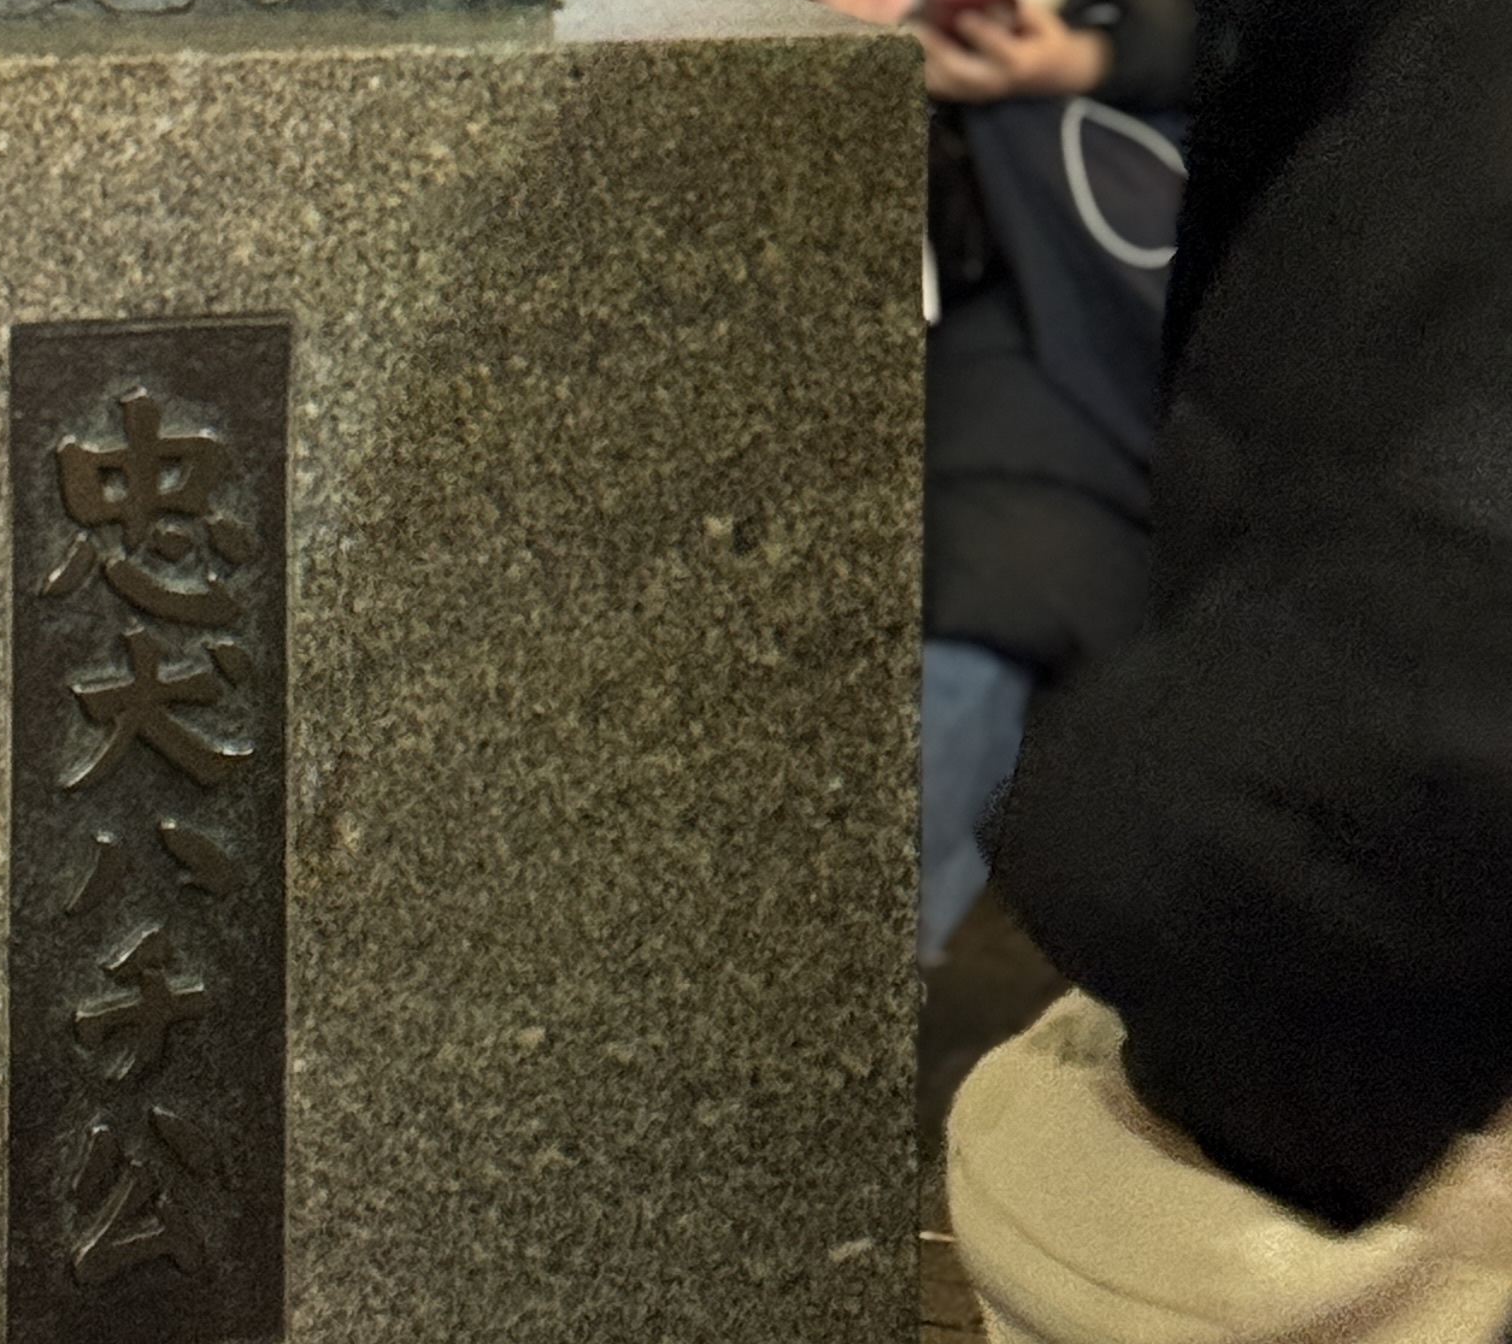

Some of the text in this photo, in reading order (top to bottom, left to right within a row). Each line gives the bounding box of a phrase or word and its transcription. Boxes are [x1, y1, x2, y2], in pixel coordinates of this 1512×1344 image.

[39, 387, 256, 1285] 忠犬ハチ公
